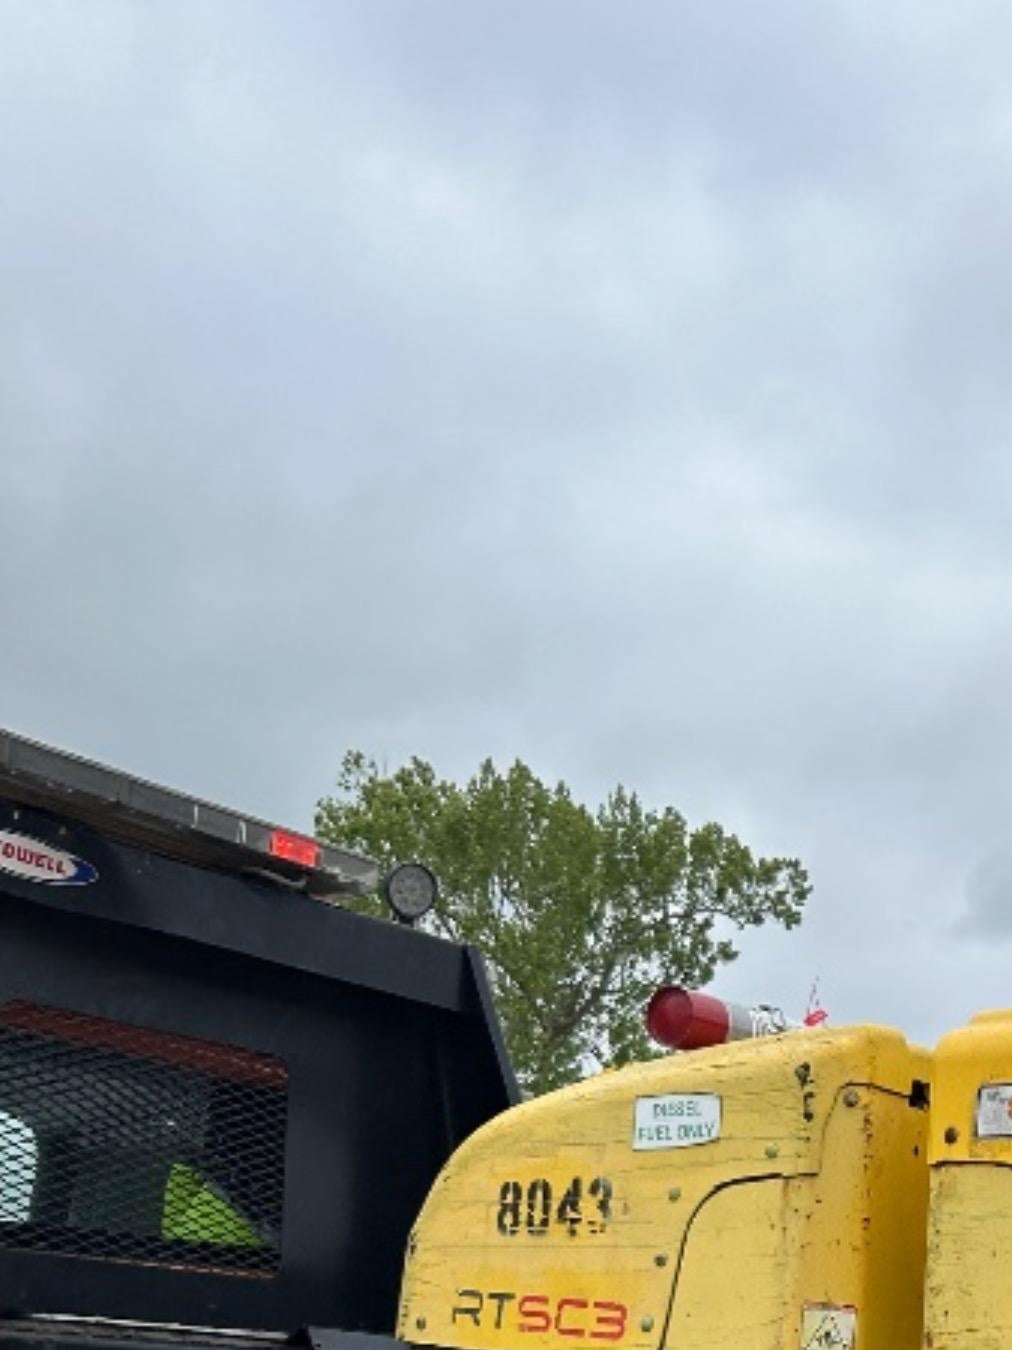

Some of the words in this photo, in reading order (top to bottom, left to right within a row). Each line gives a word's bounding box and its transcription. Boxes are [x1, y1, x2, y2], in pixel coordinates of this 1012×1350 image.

[0, 840, 66, 875] OWELL
[638, 1125, 672, 1142] FUEL
[677, 1121, 714, 1140] ONLY
[497, 1176, 613, 1237] 8043
